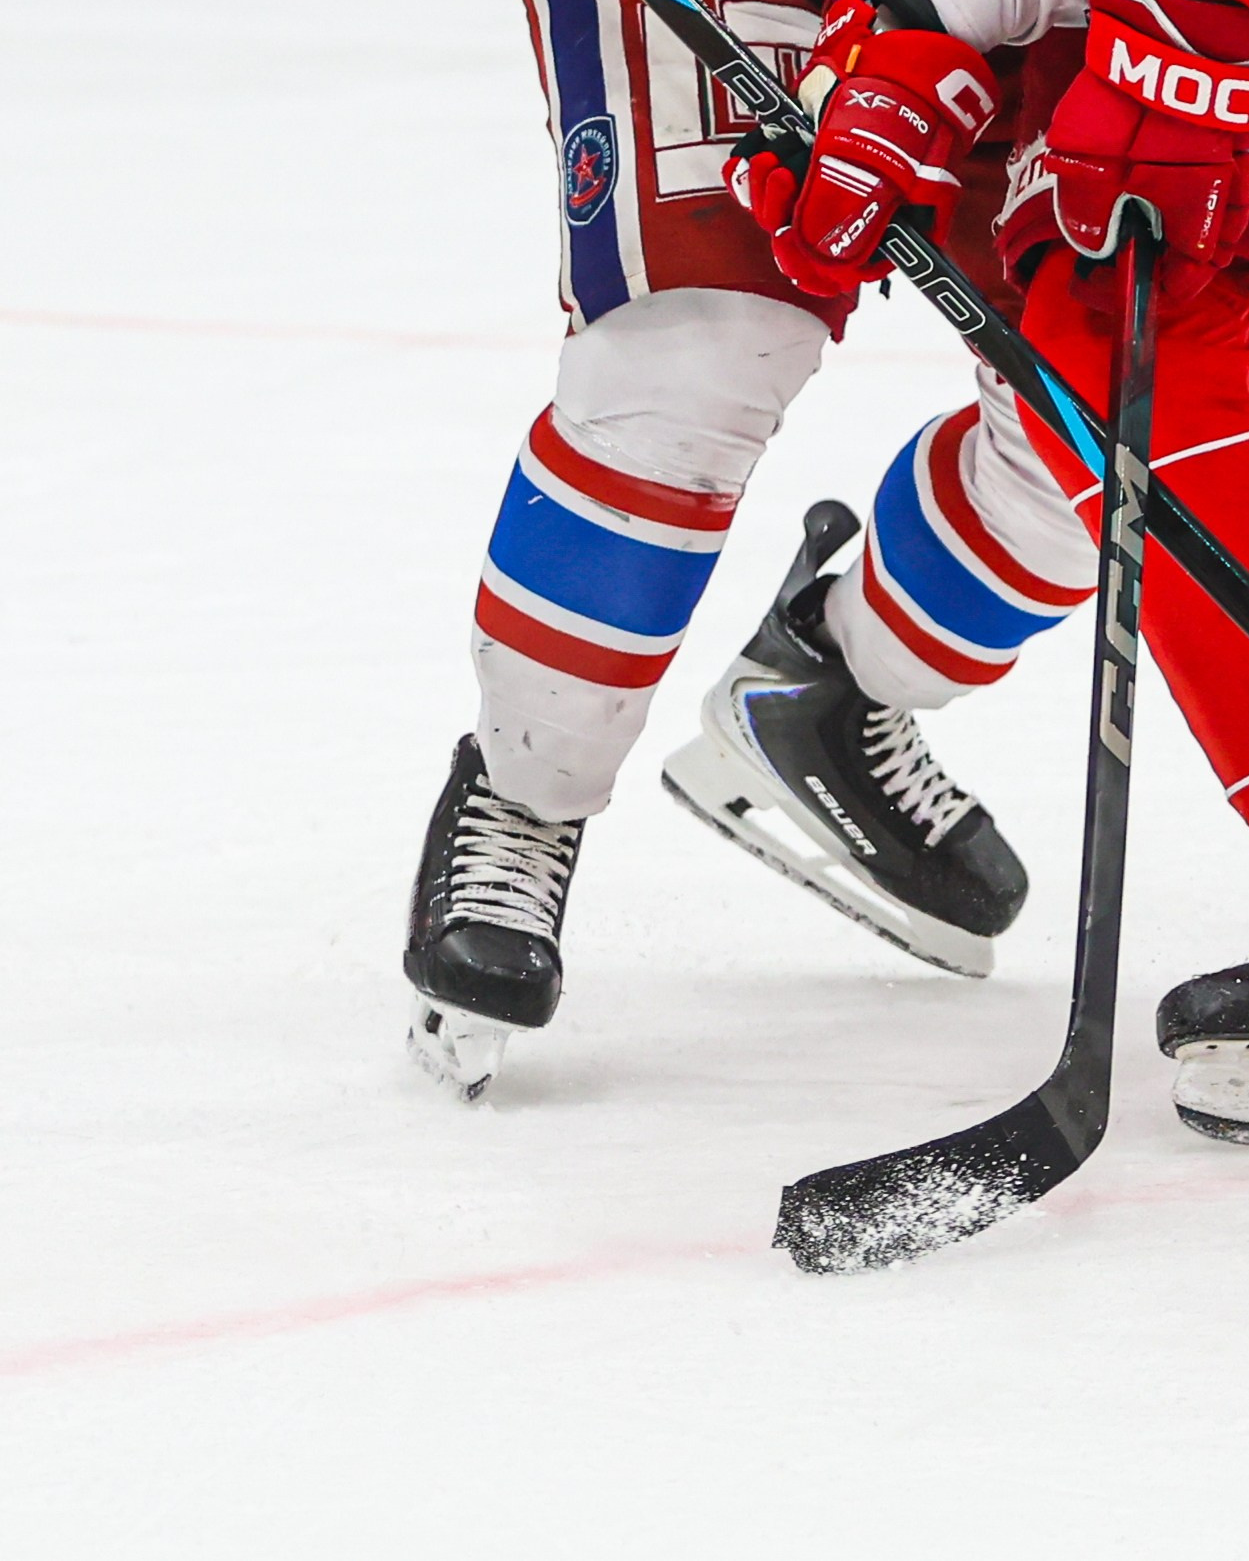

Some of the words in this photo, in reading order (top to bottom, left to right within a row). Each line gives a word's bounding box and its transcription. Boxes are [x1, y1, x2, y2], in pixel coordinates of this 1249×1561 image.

[845, 89, 897, 109] XF
[898, 105, 929, 135] PRO
[829, 201, 880, 257] CCM
[1100, 442, 1149, 768] CCM
